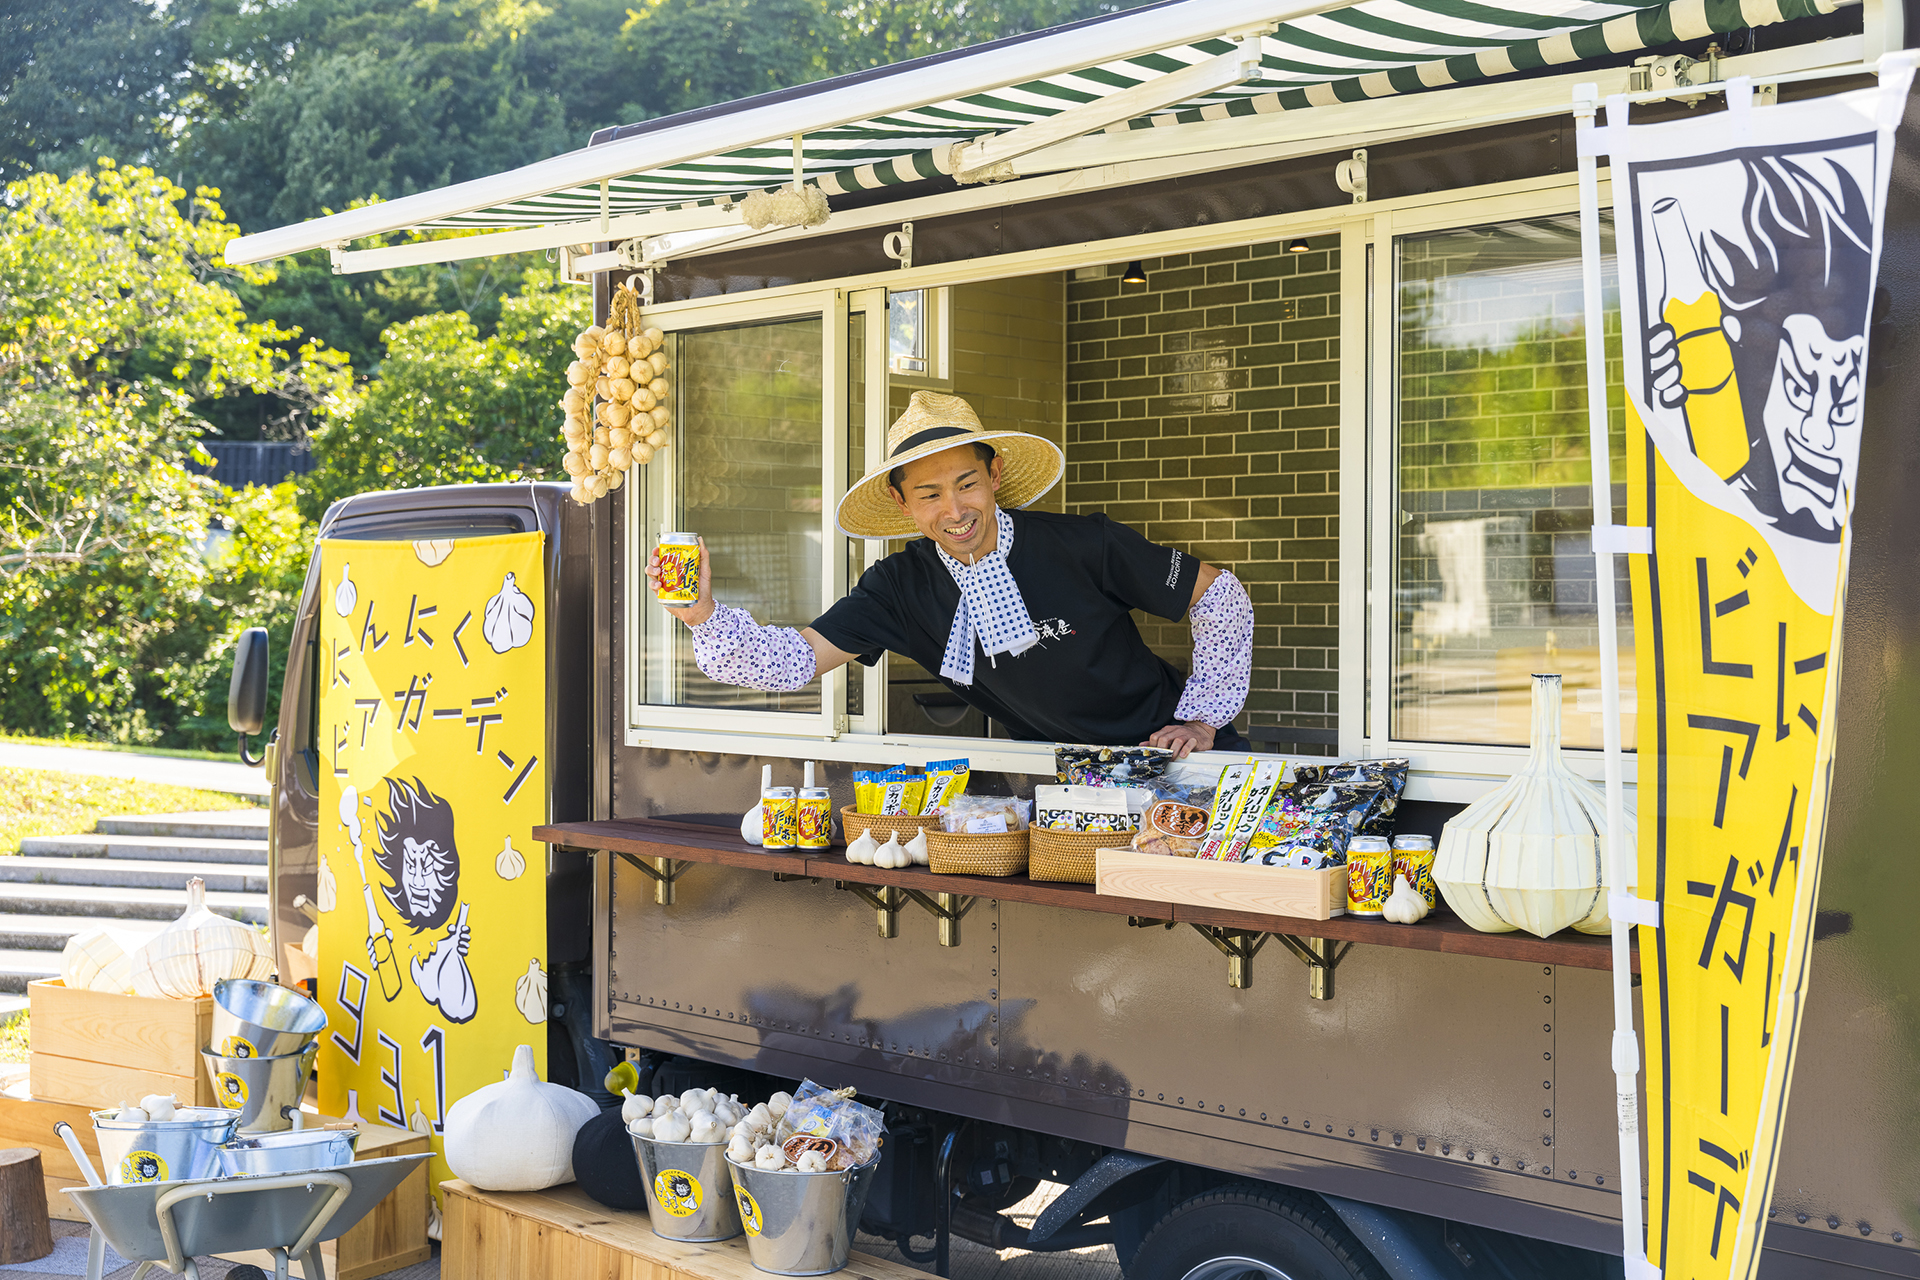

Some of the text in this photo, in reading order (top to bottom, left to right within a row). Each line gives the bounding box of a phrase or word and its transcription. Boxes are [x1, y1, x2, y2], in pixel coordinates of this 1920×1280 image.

[1169, 551, 1182, 590] AOMORIYA
[332, 593, 472, 689] にんにく
[333, 672, 539, 806] ビアガーデン
[1213, 784, 1242, 831] ガーリック
[1240, 785, 1272, 833] ガーリック
[1686, 547, 1765, 1280] ビアガーデ
